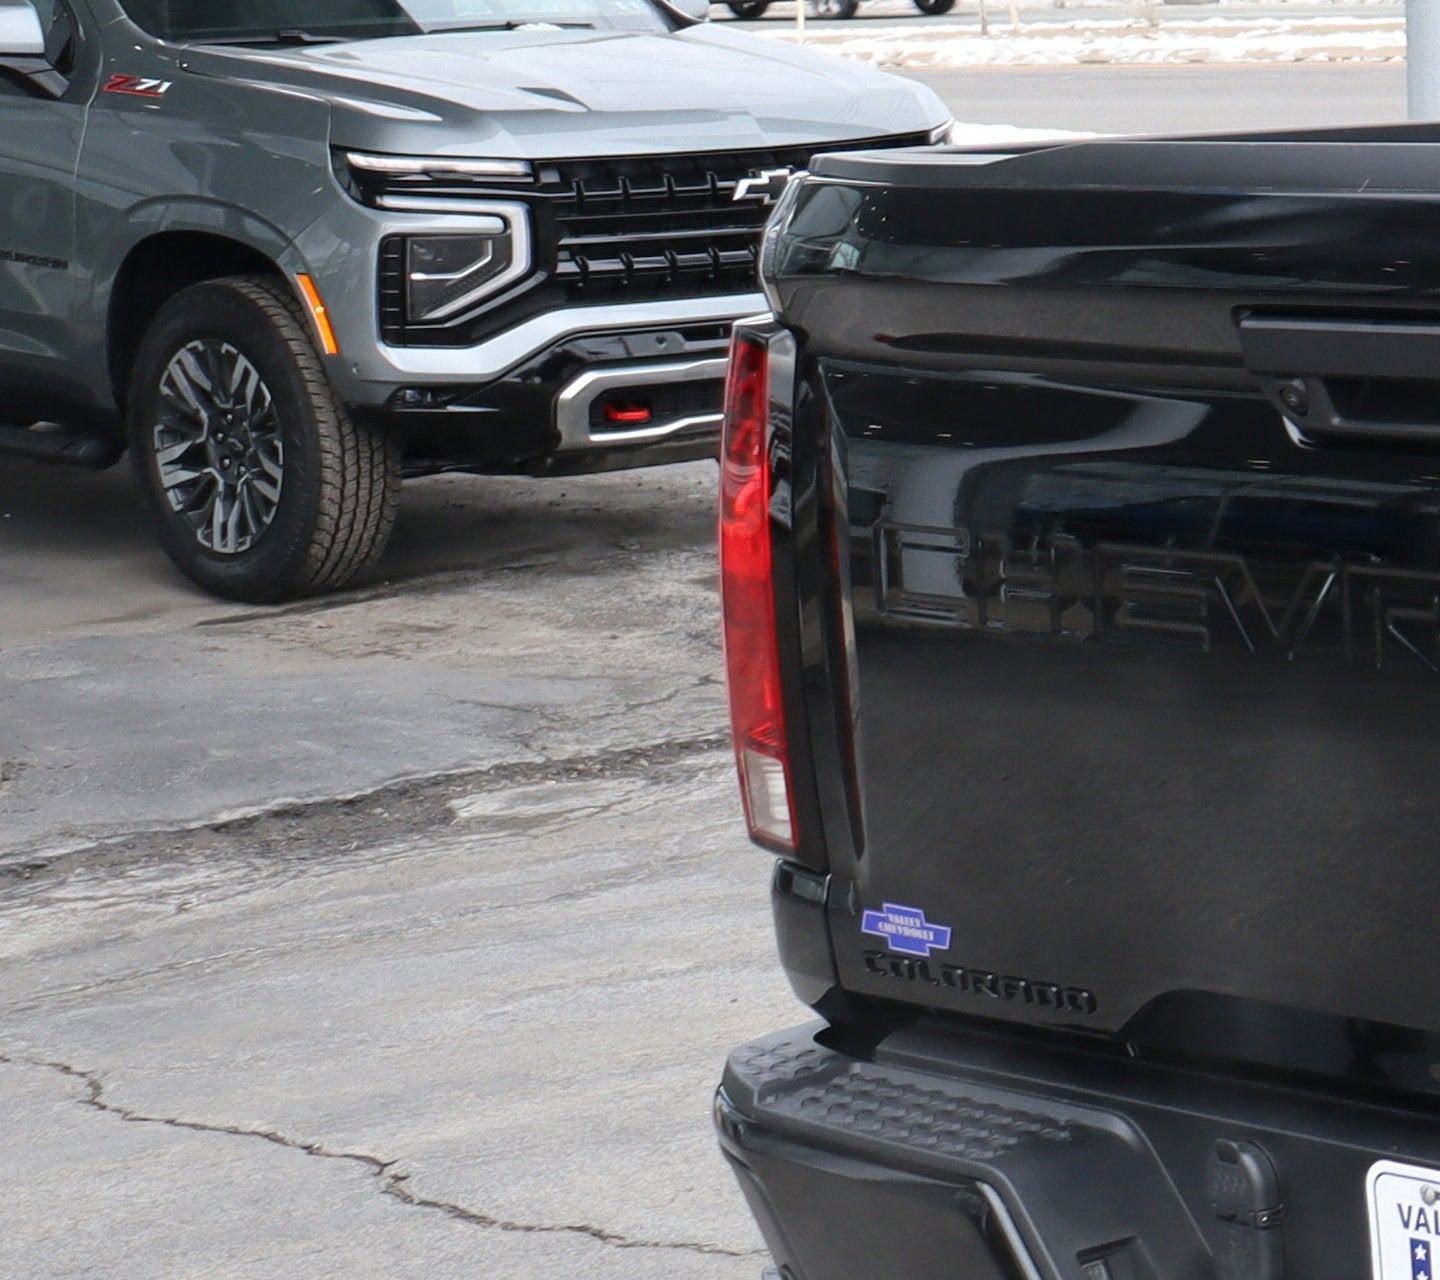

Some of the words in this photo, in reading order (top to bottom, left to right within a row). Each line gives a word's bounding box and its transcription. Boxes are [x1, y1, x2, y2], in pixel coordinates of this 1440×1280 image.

[103, 73, 173, 98] Z71
[878, 921, 934, 941] CHEVROLET
[888, 913, 921, 928] VALLEY
[862, 950, 1097, 1015] COLORADO
